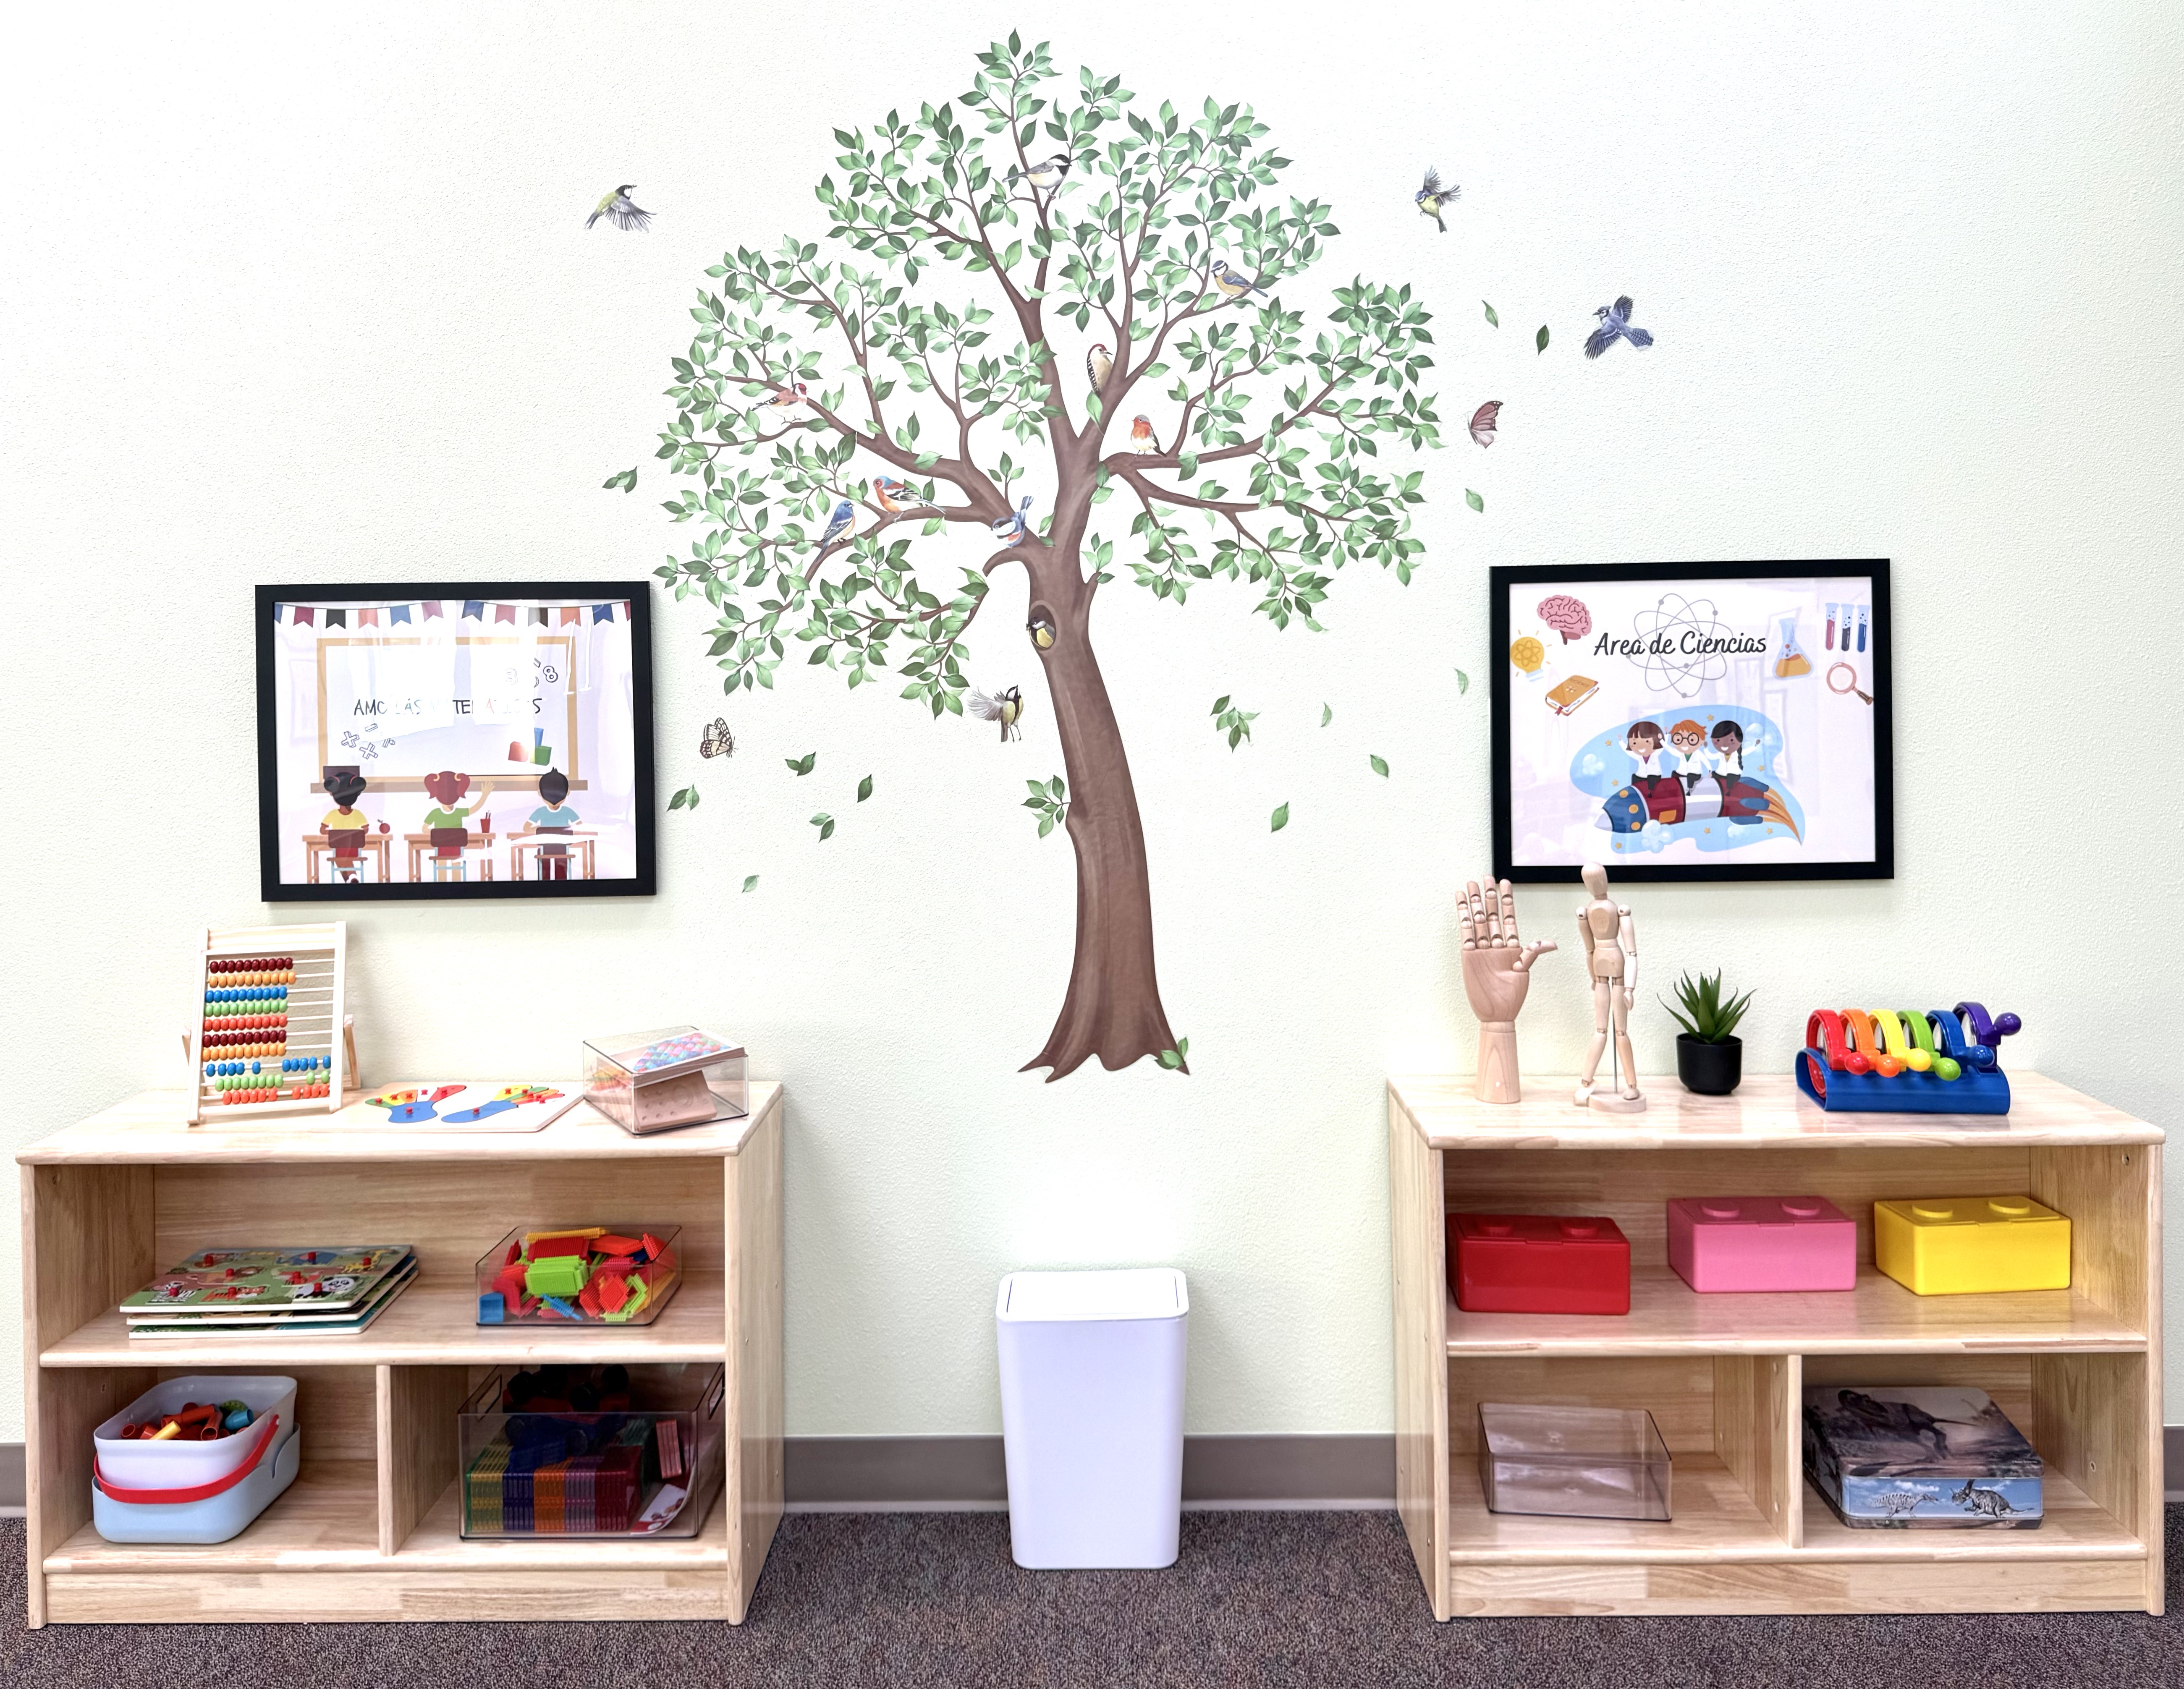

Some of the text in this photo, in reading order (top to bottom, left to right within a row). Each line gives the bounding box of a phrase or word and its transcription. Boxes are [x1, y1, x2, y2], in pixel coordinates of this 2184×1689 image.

[1594, 631, 1766, 656] Area de Ciencias
